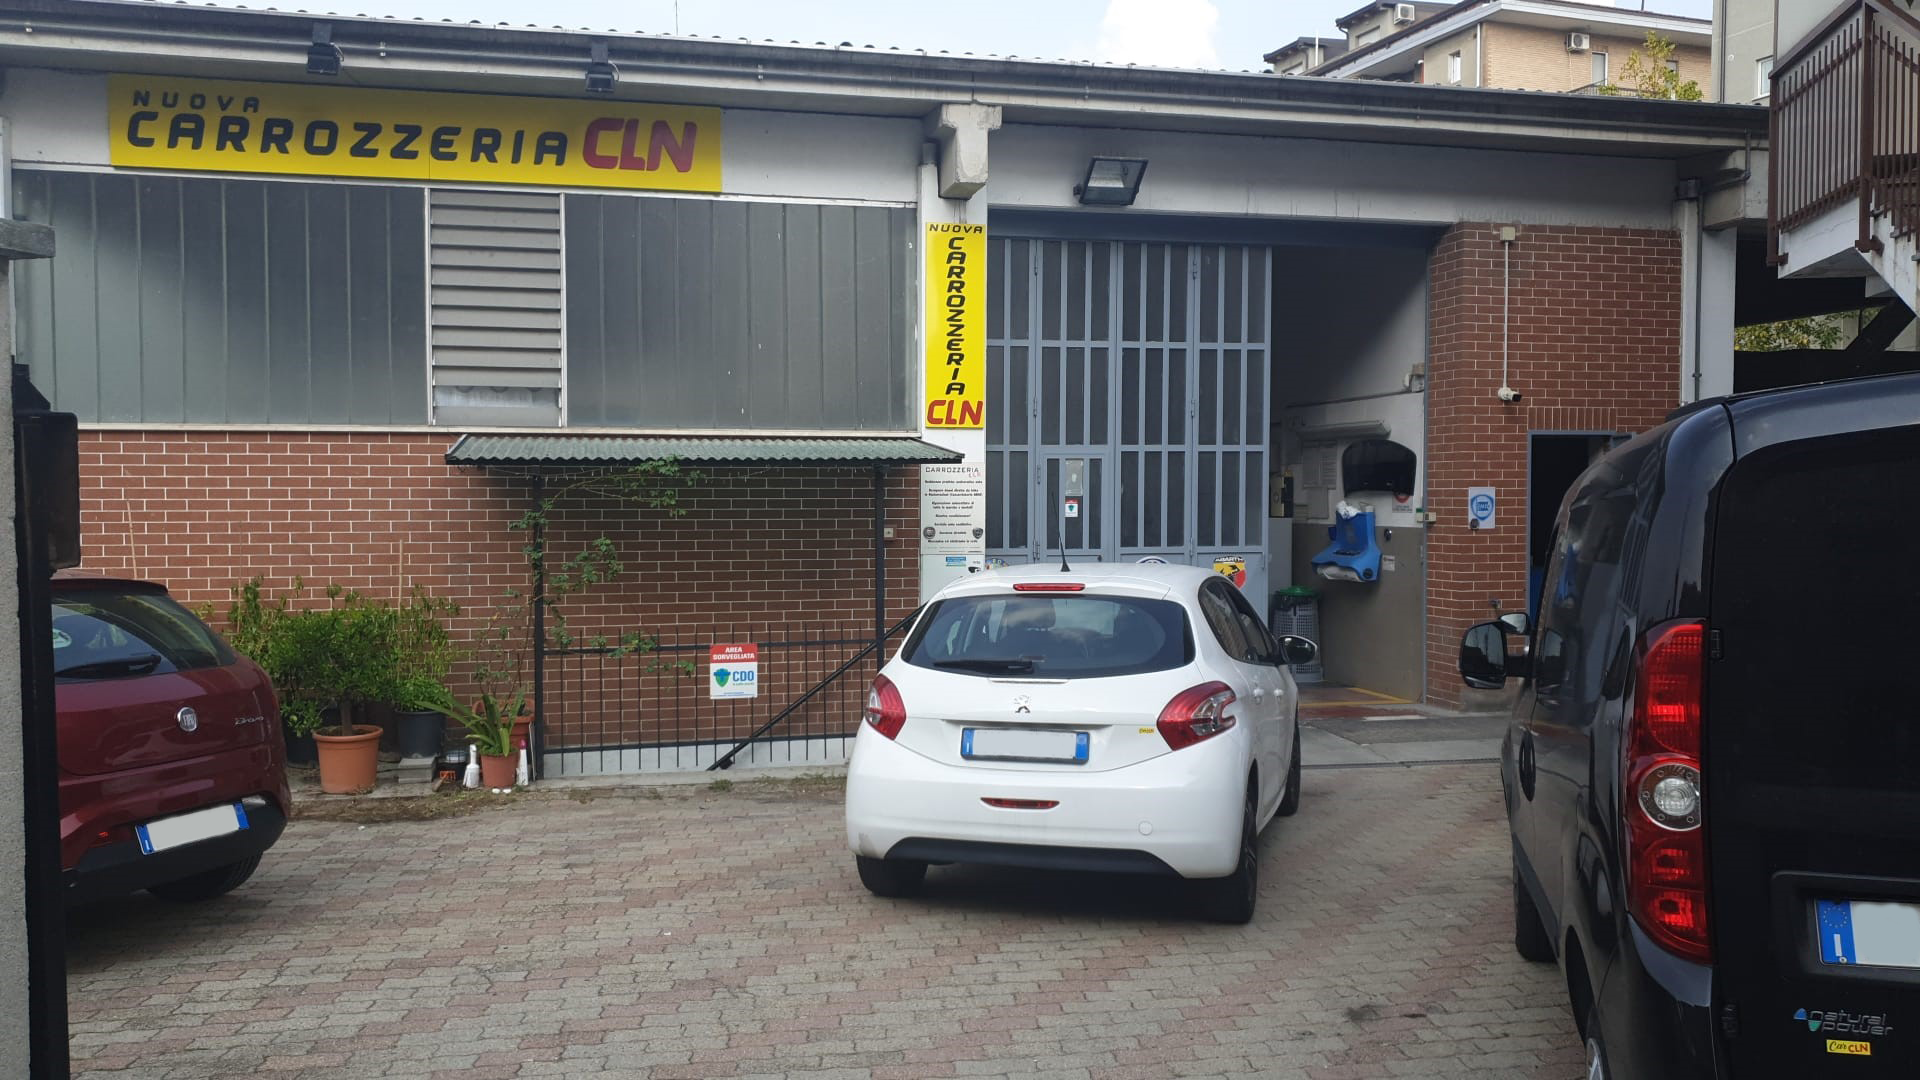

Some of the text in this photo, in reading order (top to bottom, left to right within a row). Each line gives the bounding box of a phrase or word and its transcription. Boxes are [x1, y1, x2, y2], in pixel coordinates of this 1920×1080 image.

[133, 90, 260, 113] NUOVA
[127, 110, 698, 173] CARROZZERIA CLN
[929, 224, 983, 234] NUOVA
[946, 237, 967, 395] CARROZZERIA
[927, 400, 983, 426] CLN
[732, 670, 755, 682] CDO
[1810, 1010, 1886, 1025] natural
[1821, 1021, 1893, 1035] power
[1829, 1041, 1869, 1053] Car CLN
